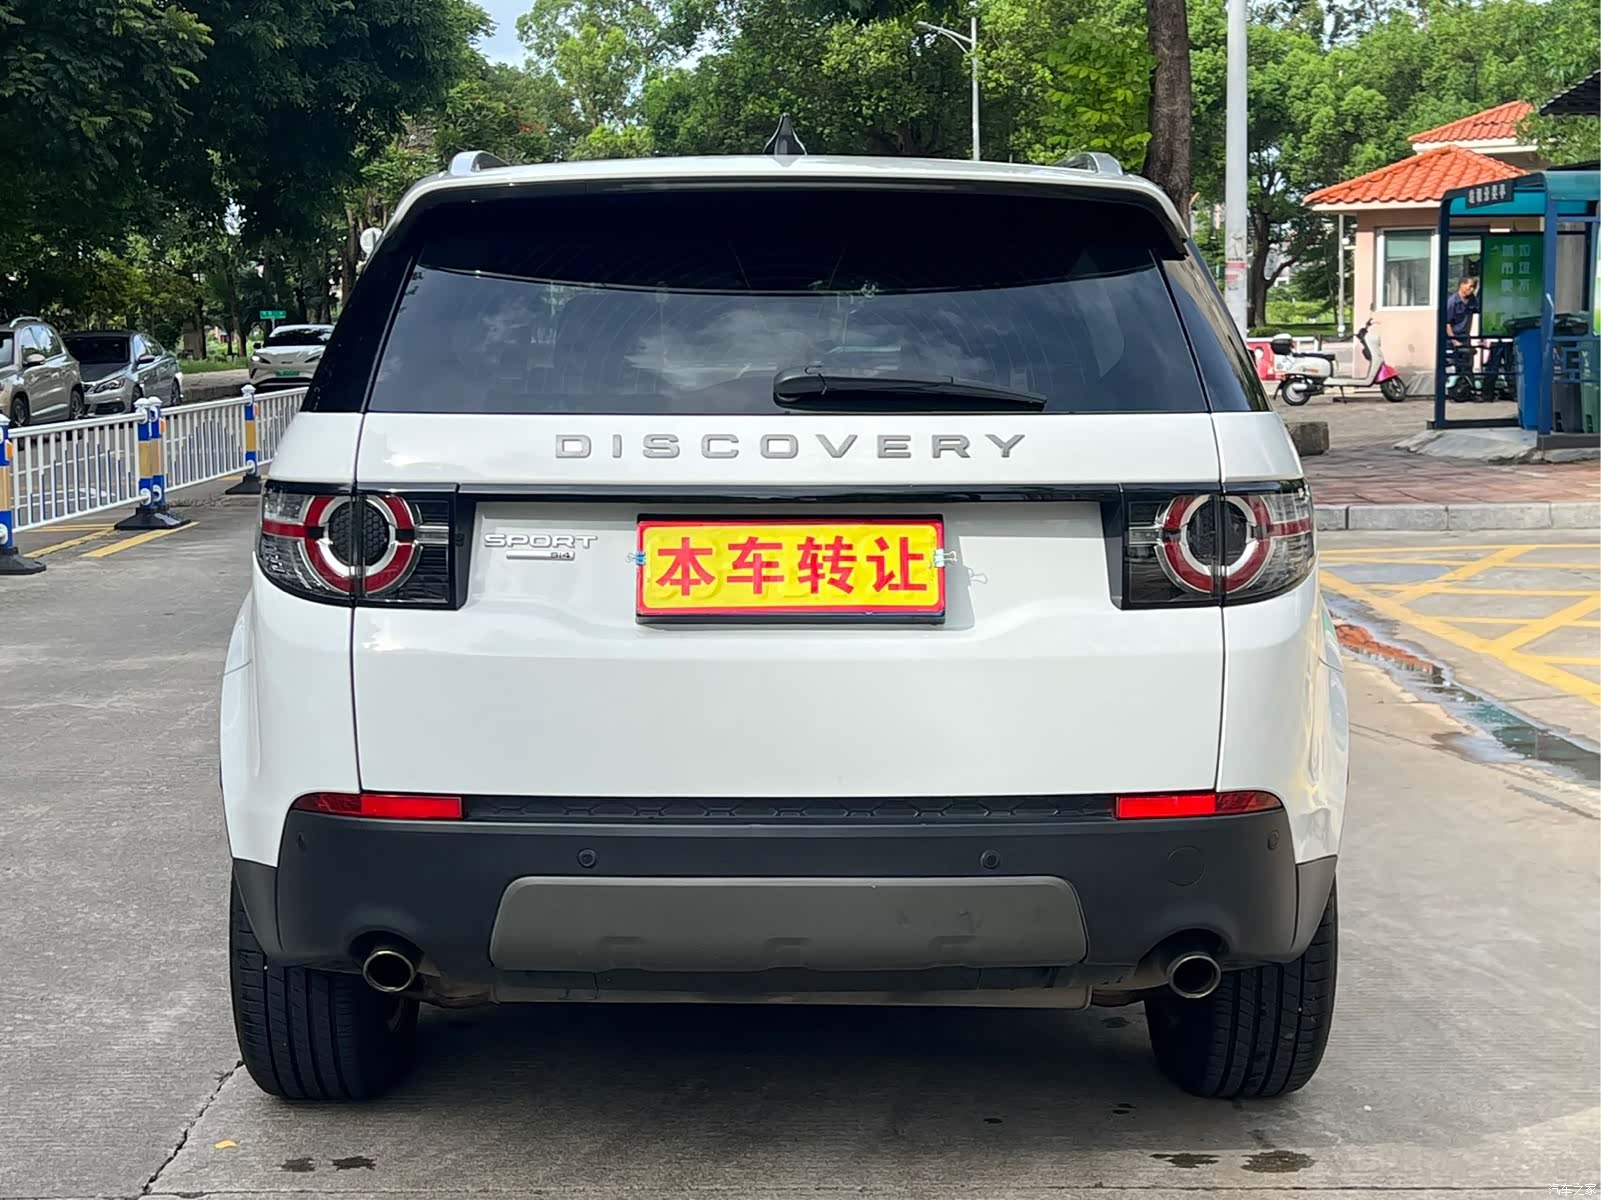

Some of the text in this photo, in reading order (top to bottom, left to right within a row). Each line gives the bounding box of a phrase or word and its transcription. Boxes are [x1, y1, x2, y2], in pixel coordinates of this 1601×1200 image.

[555, 434, 1026, 458] DISCOVERY
[484, 533, 598, 549] SPORT
[656, 536, 928, 596] 本车转让
